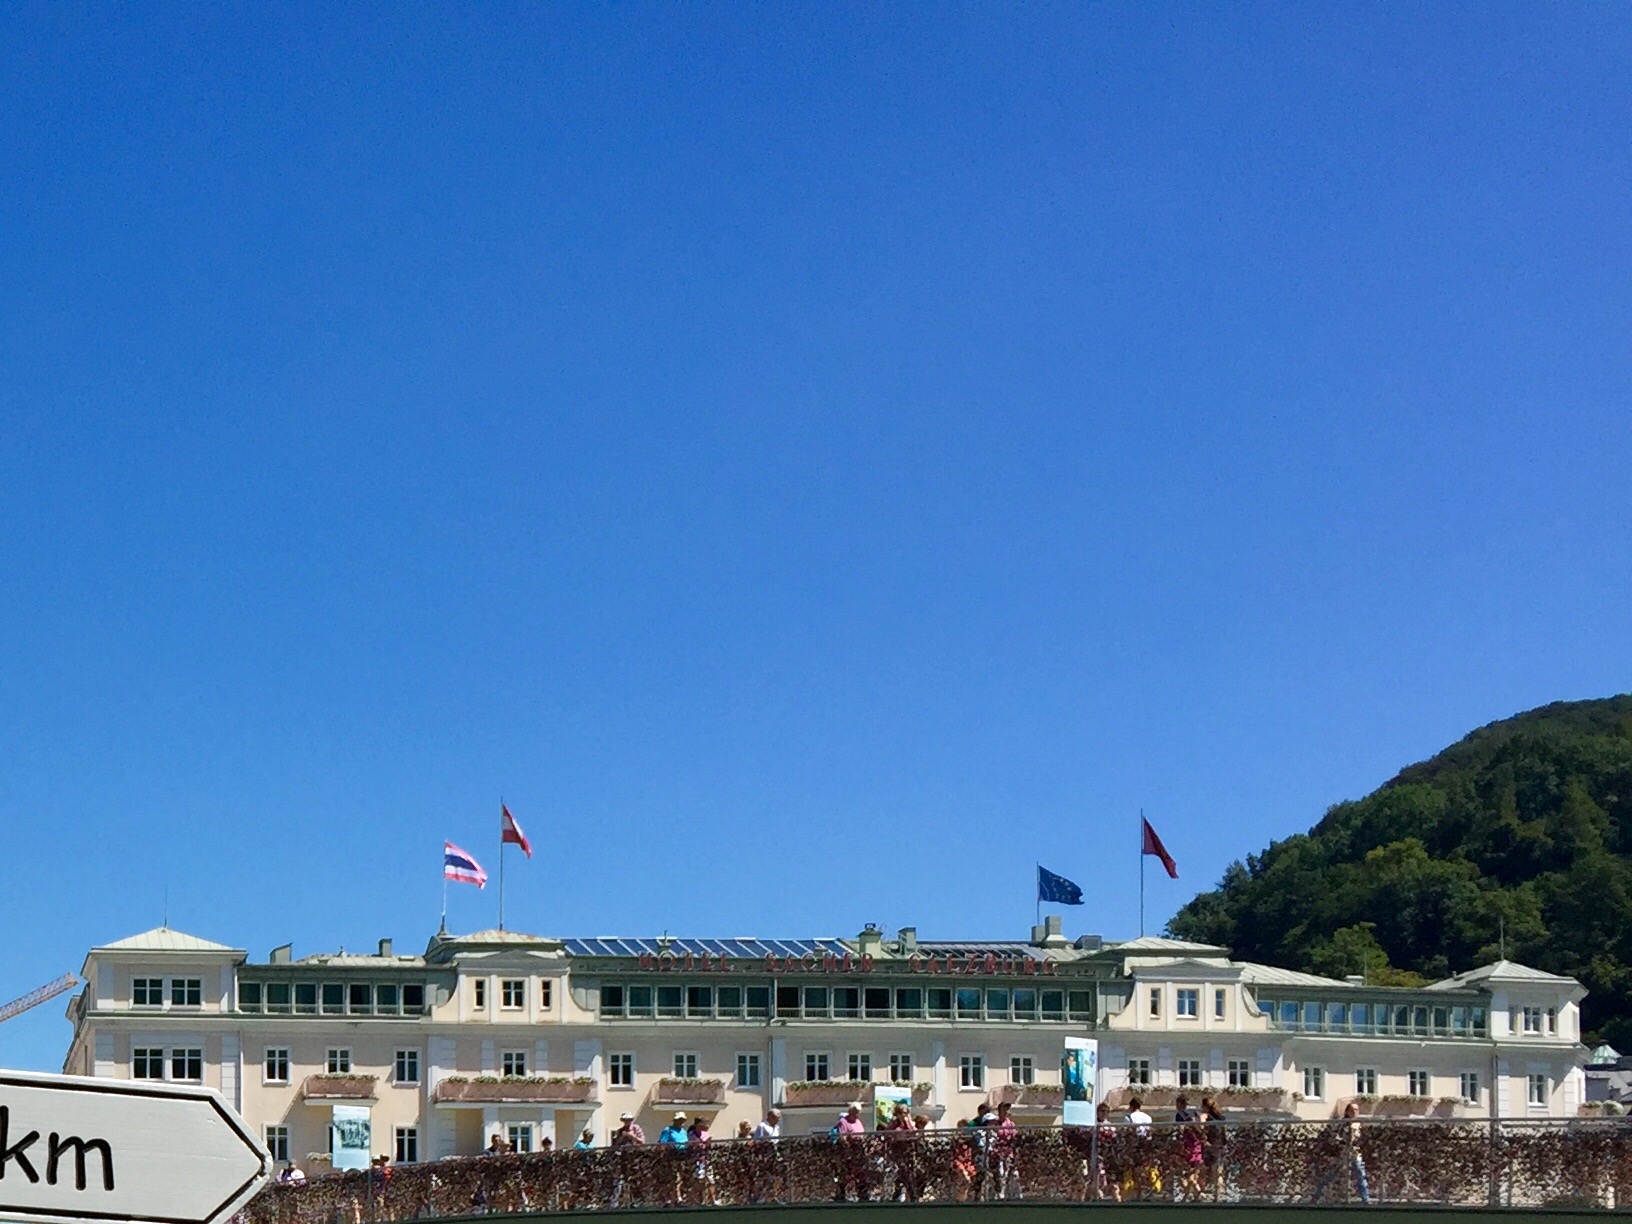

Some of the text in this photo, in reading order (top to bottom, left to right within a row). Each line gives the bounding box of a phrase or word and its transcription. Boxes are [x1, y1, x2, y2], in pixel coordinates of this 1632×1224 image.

[638, 951, 1058, 977] HOTEL SACHER SALZBURG
